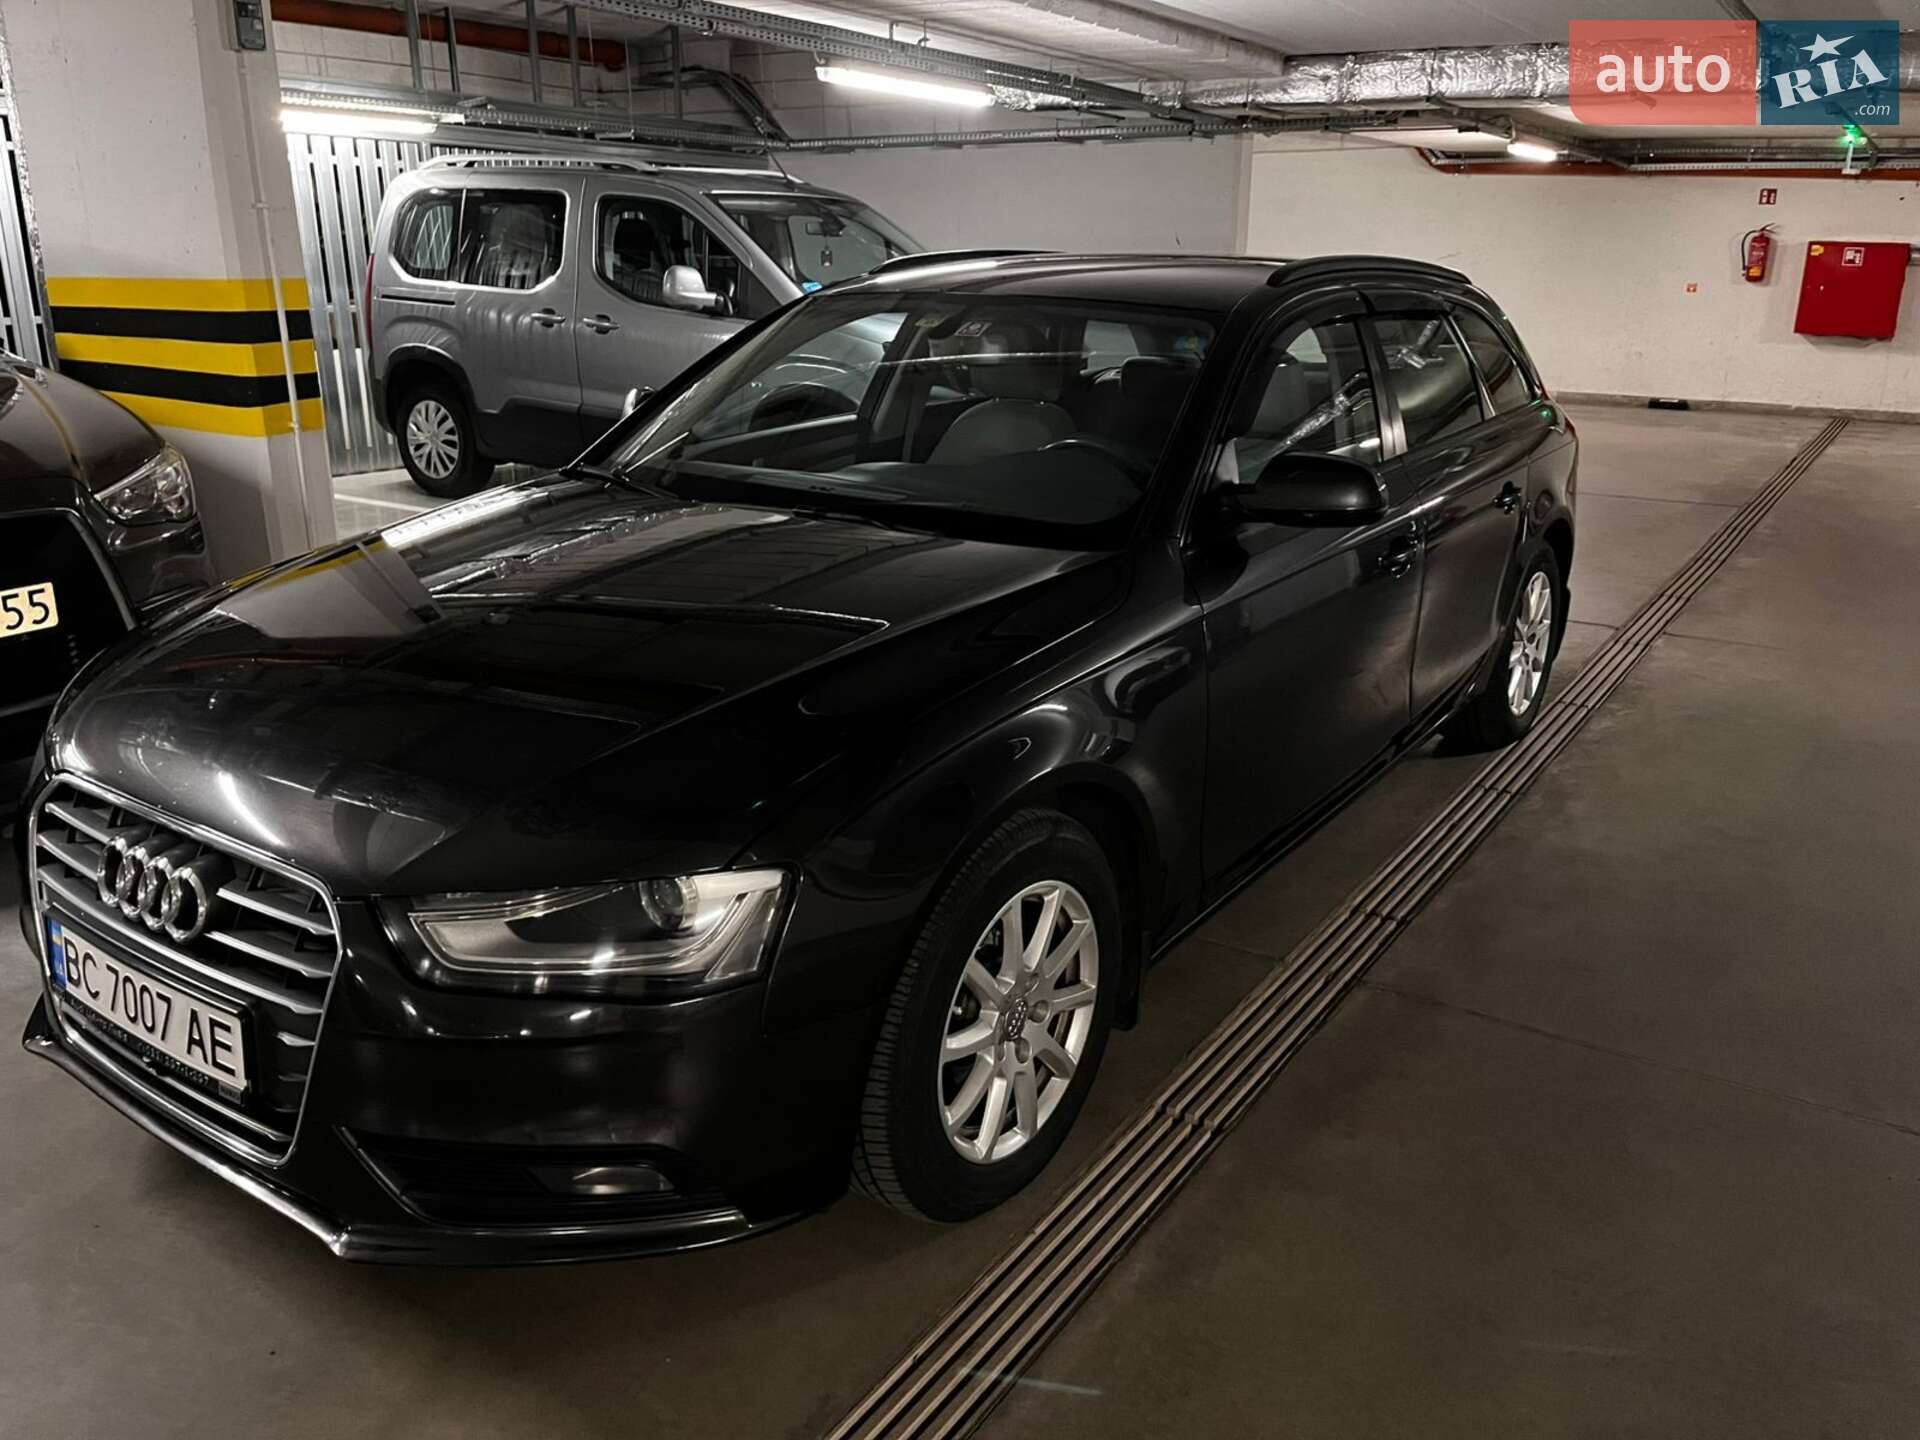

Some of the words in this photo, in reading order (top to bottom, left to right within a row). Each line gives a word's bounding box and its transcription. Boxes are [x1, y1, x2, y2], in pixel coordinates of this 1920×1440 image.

[64, 937, 100, 999] BC
[106, 965, 172, 1041] 7007
[187, 1007, 236, 1077] AE
